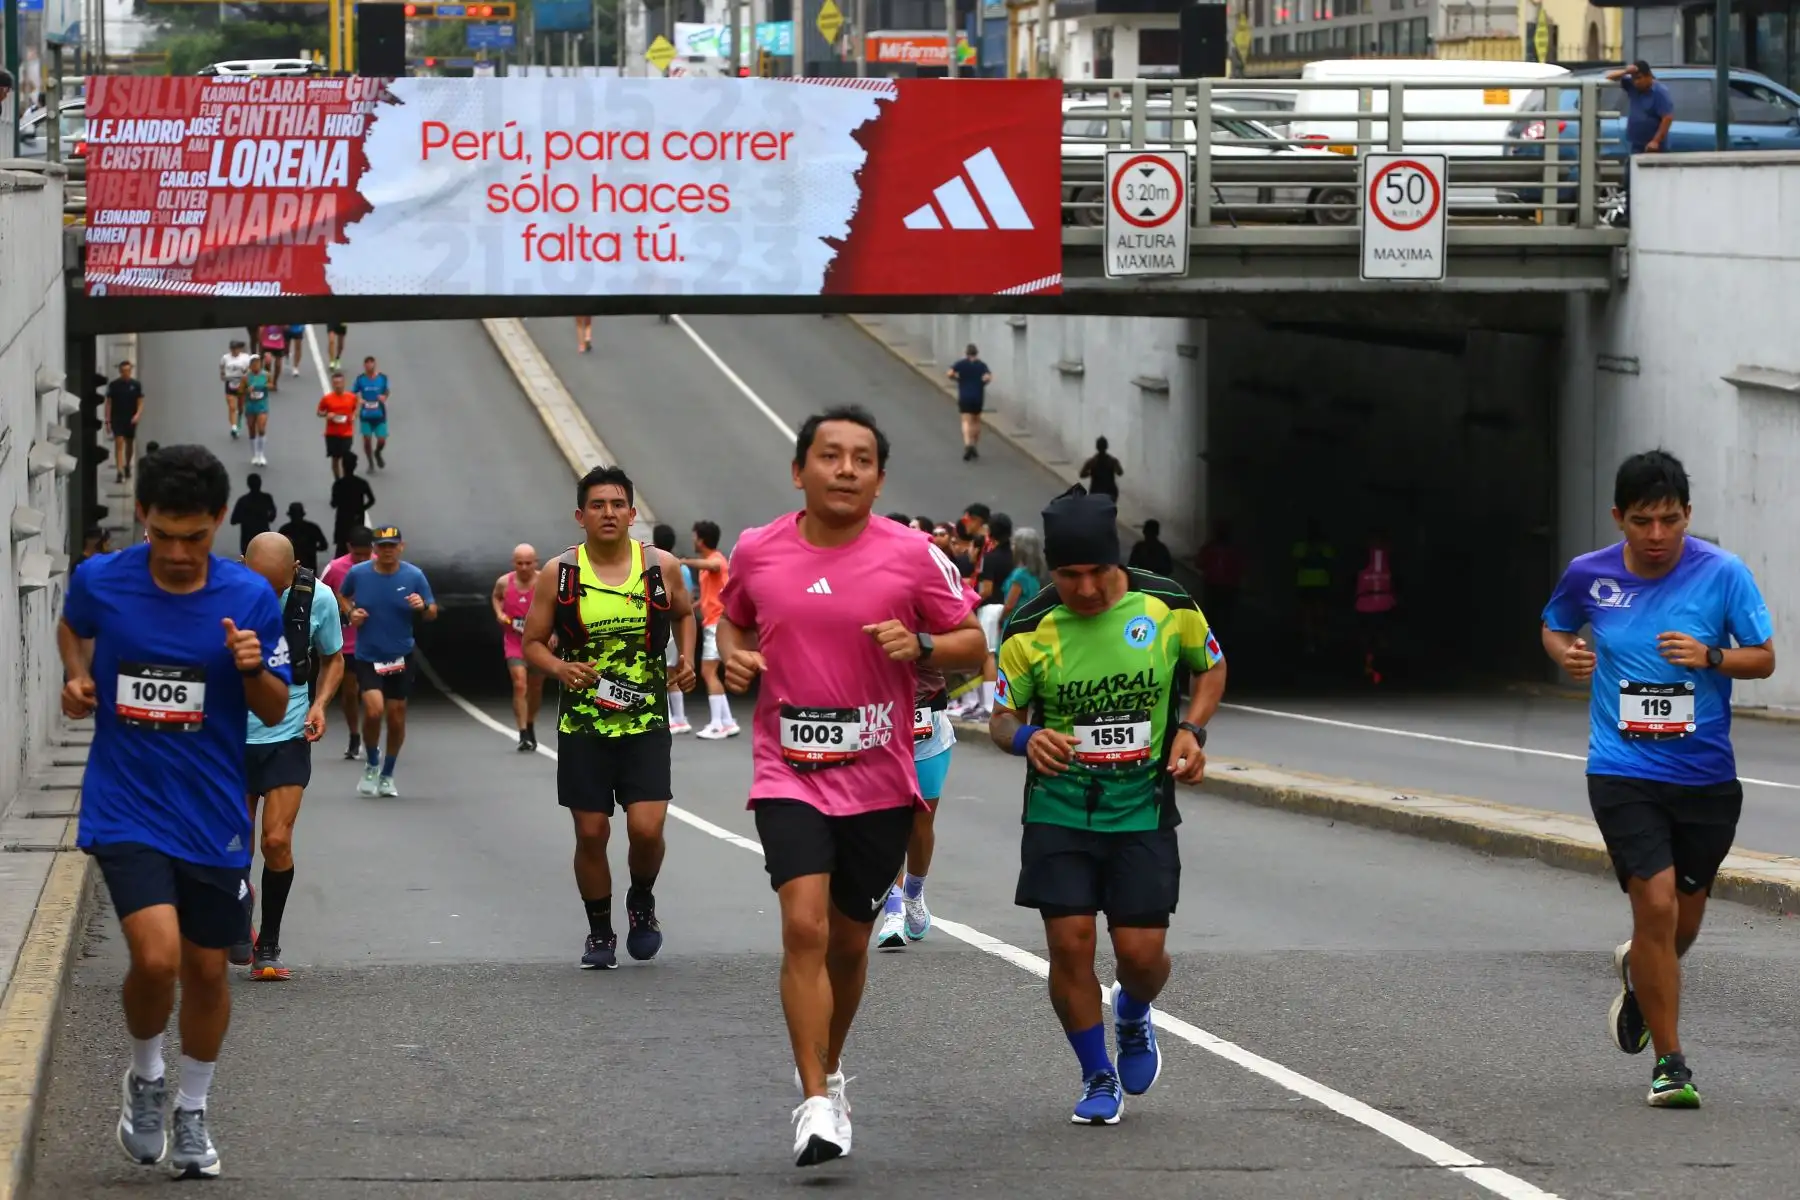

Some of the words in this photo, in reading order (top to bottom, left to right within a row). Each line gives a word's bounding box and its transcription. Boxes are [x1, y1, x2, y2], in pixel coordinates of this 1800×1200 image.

[109, 76, 203, 116] SULLY
[201, 86, 246, 102] KARINA
[249, 80, 305, 103] CLARA
[185, 114, 222, 136] JOSÉ
[223, 104, 320, 137] CINTHIA
[323, 114, 364, 137] HIRO
[422, 120, 532, 164] Perú,
[545, 130, 650, 170] para
[662, 130, 795, 161] correr
[100, 146, 183, 170] CRISTINA
[207, 139, 349, 188] LORENA
[159, 171, 208, 188] CARLOS
[1387, 173, 1425, 204] 50
[156, 190, 208, 209] OLIVER
[486, 173, 580, 213] sólo
[592, 174, 731, 213] haces
[1126, 184, 1169, 201] 3.20m
[93, 210, 151, 225] LEONARDO
[172, 210, 207, 225] LARRY
[120, 227, 201, 266] ALDO
[521, 223, 621, 262] falta
[633, 223, 685, 262] tú.
[1117, 234, 1176, 248] ALTURA
[195, 246, 292, 280] CAMILA
[1116, 255, 1175, 269] MAXIMA
[1374, 248, 1433, 260] MAXIMA
[132, 681, 188, 704] 1006
[1057, 668, 1160, 703] HUARAL
[915, 711, 922, 723] 3
[1641, 699, 1672, 716] 119
[790, 724, 843, 745] 1003
[1091, 727, 1135, 746] 1551
[806, 752, 824, 760] 42K
